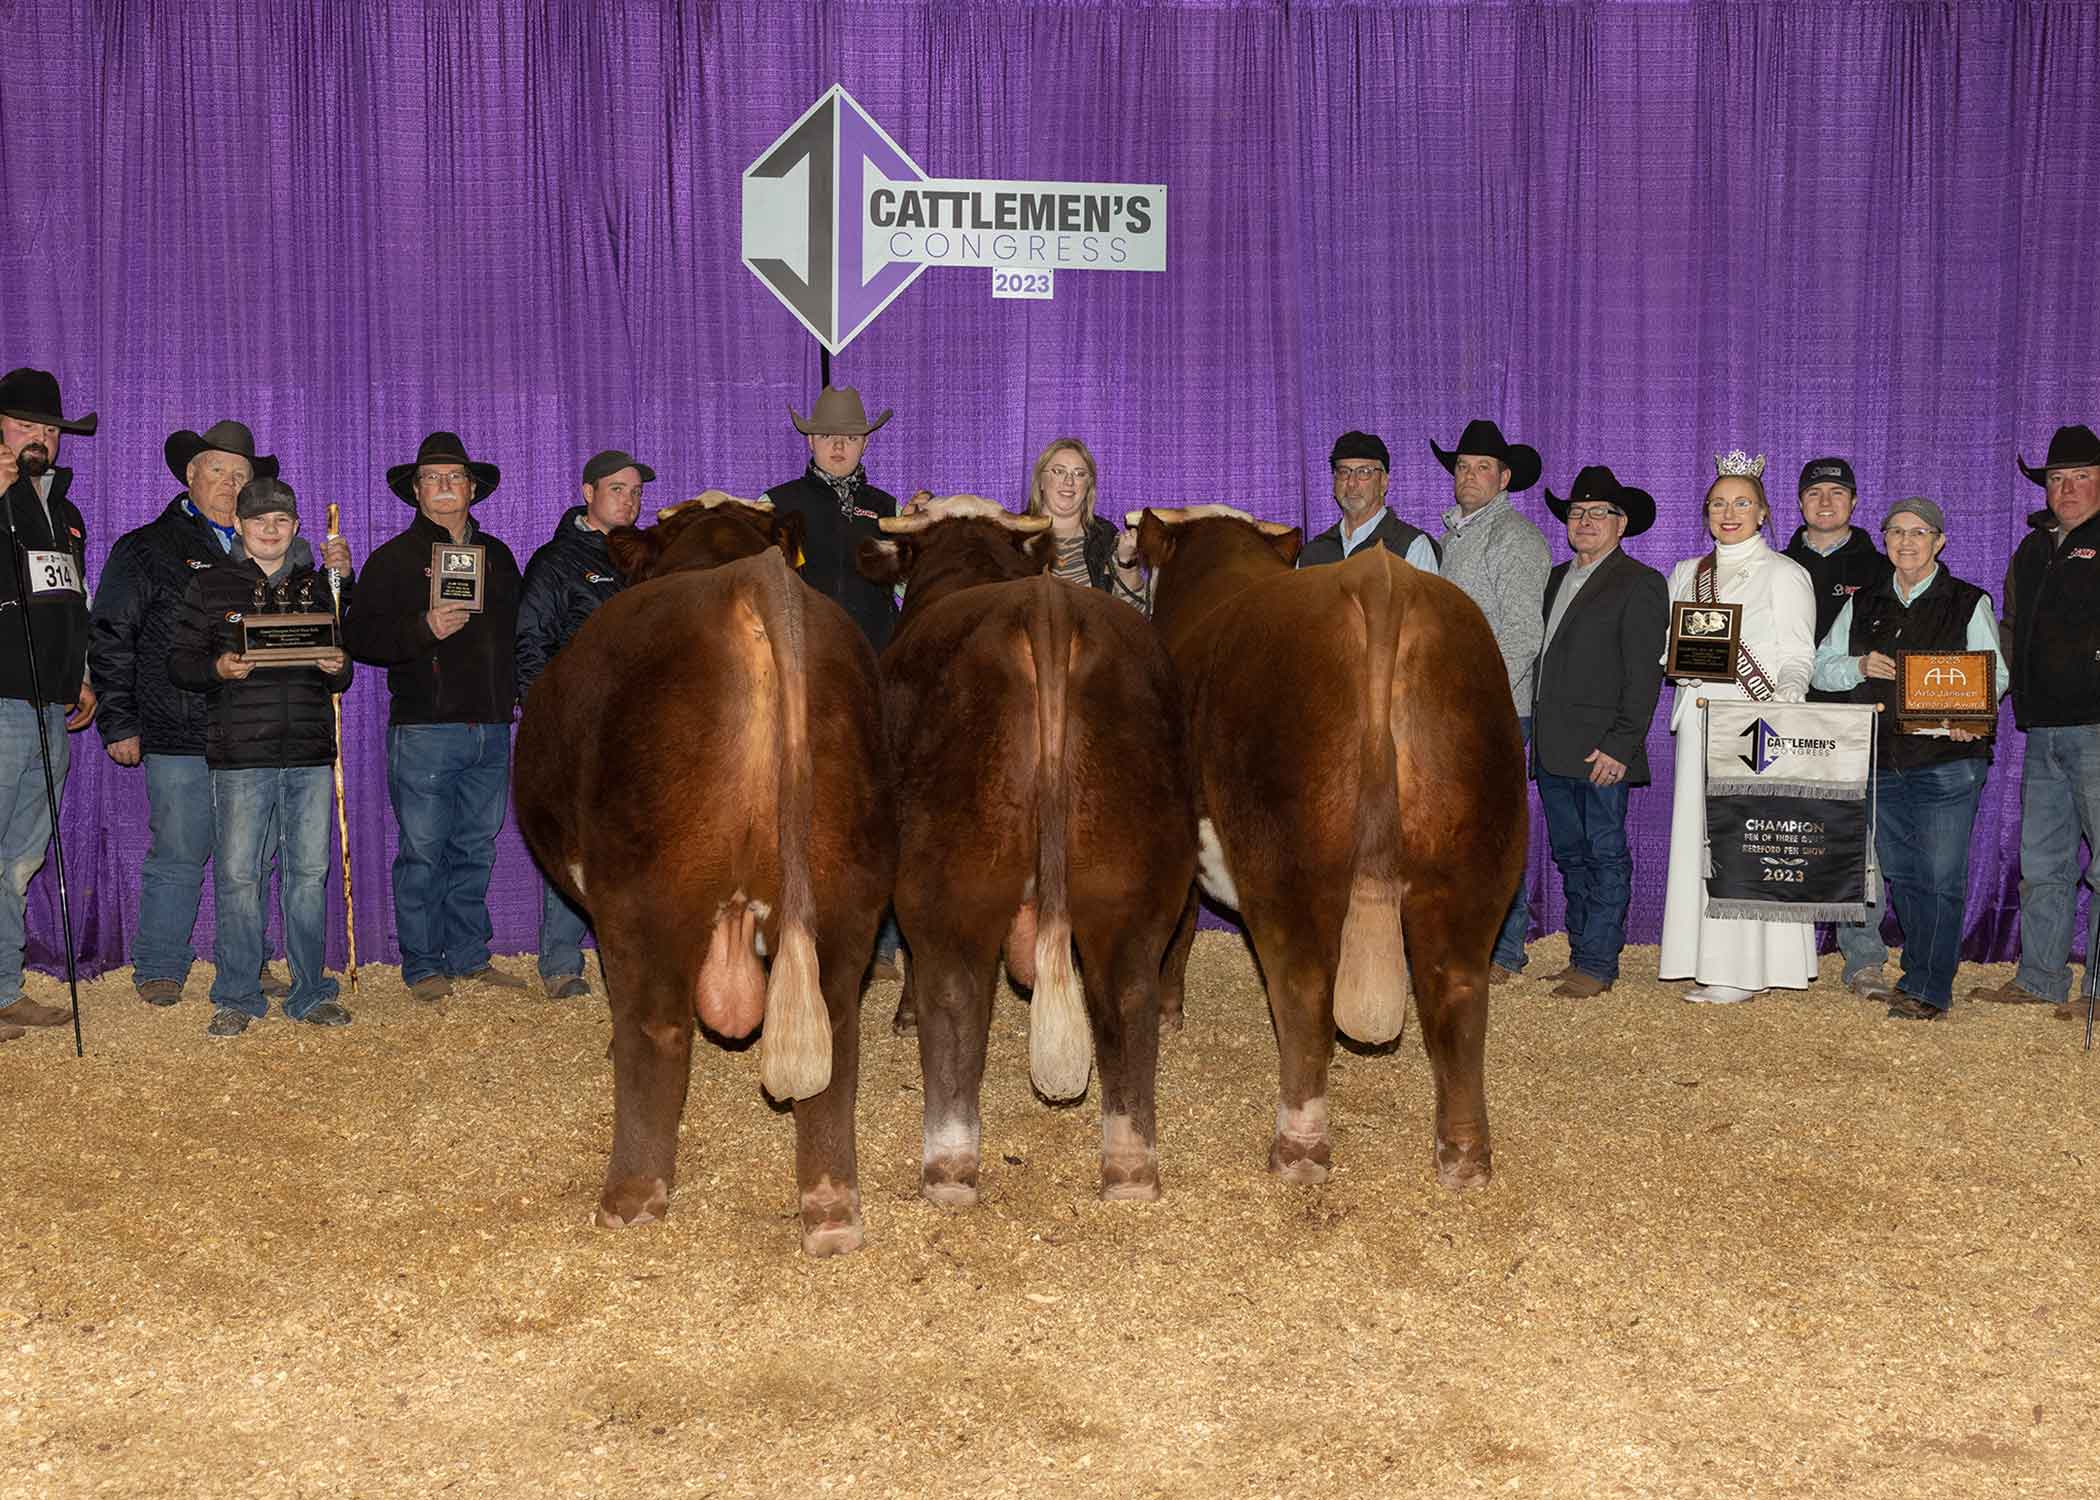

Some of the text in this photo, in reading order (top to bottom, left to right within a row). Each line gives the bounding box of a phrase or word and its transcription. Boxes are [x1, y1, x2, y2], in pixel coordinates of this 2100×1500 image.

[870, 188, 1152, 234] CATTLEMEN'S
[889, 231, 1128, 263] CONGRESS
[995, 273, 1051, 294] 2023
[44, 564, 72, 588] 314
[1767, 737, 1836, 750] CATTLEMEN'S
[1772, 748, 1831, 758] CONGRESS
[1745, 819, 1825, 833] CHAMPION
[1744, 833, 1759, 841] PEN
[1776, 834, 1799, 843] THREE
[1742, 844, 1825, 856] HEREFORD PEN SHOW
[1763, 868, 1805, 882] 2023
